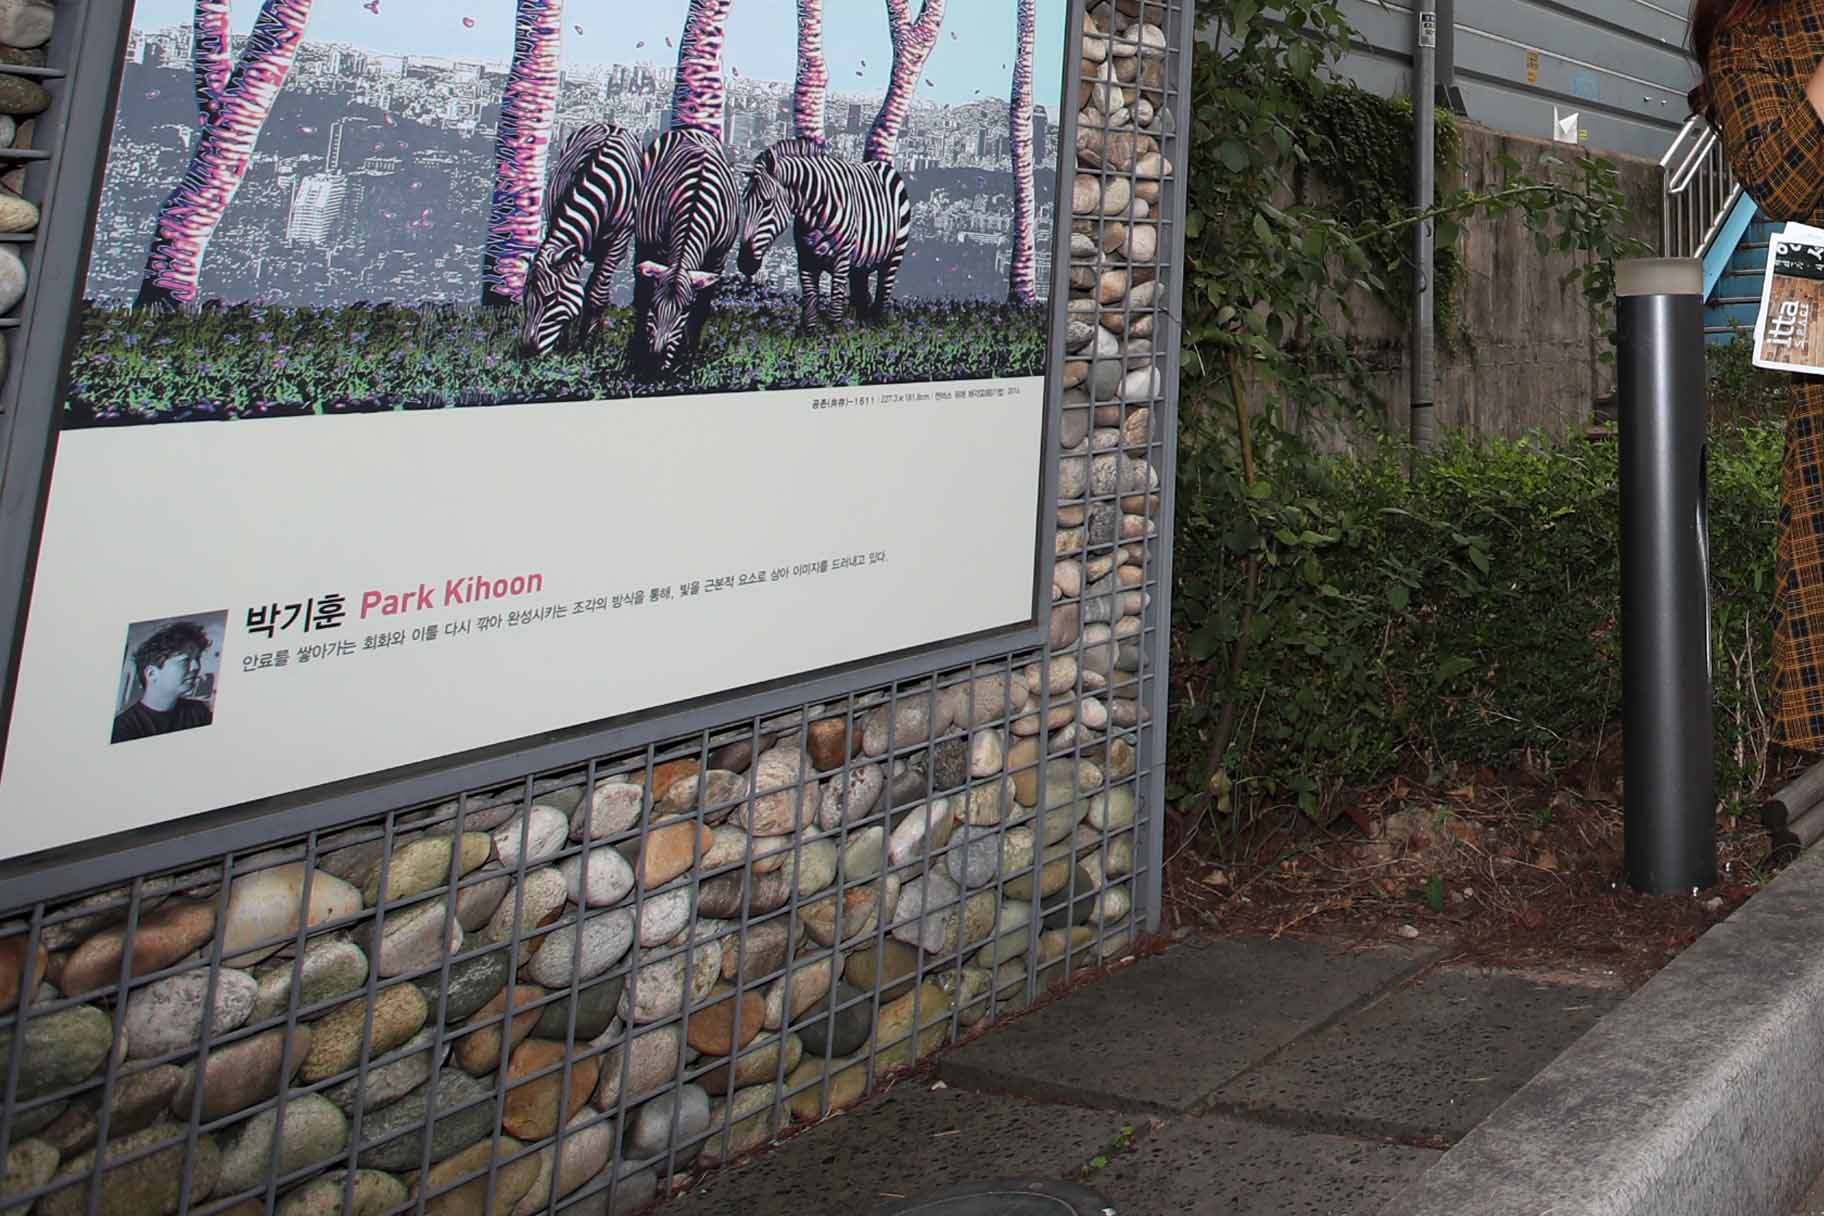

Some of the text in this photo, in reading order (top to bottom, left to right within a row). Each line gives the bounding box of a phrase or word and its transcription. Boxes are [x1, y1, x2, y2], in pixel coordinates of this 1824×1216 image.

[242, 649, 290, 672] 안료를
[297, 639, 356, 663] 쌓아가는
[363, 630, 405, 650] 회화와
[412, 624, 438, 641] 이를
[445, 619, 471, 636] 다시
[507, 603, 568, 627] 완성시키는
[572, 596, 608, 616] 조각의
[611, 591, 645, 609] 방식을
[738, 570, 766, 586] 요소로
[793, 560, 829, 577] 이미지를
[246, 573, 543, 638] 박기훈 Park Kihoon
